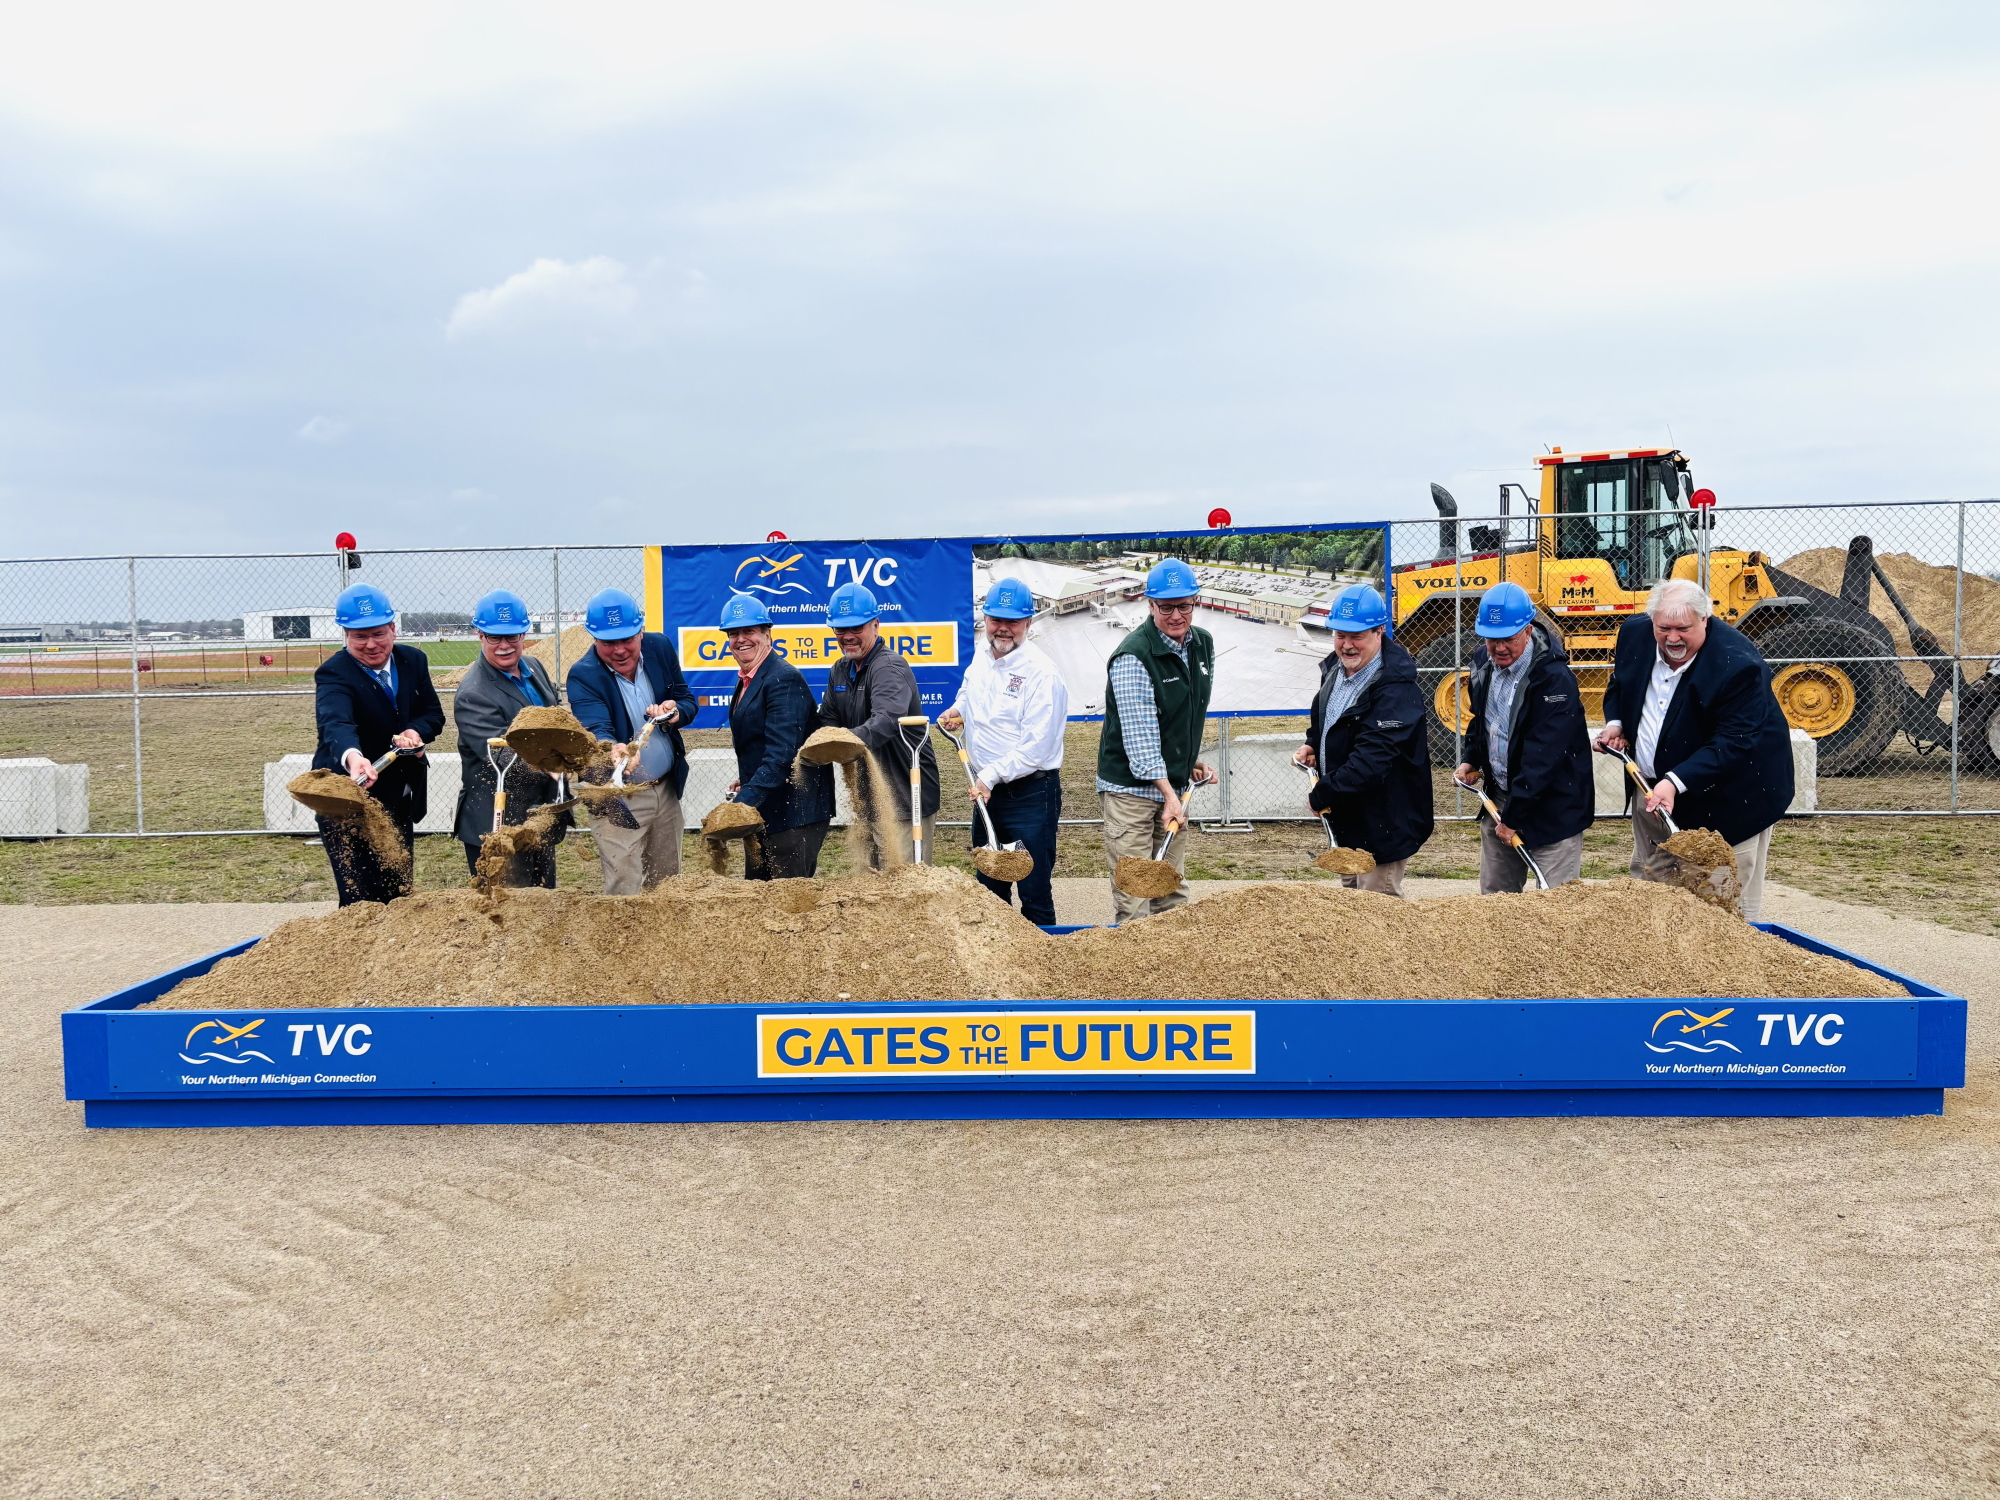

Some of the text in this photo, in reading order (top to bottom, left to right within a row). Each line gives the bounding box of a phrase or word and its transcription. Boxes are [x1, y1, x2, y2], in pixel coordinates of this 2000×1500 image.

[823, 557, 898, 587] TVC
[1413, 576, 1488, 589] VOLVO
[1562, 586, 1594, 598] M&M
[767, 604, 797, 613] rthern
[796, 637, 814, 647] TO
[792, 649, 818, 659] THE
[921, 693, 943, 701] MER
[1757, 1013, 1845, 1046] TVC
[287, 1023, 373, 1056] TVC
[776, 1023, 1232, 1066] GATES TO THE FUTURE
[1645, 1063, 1847, 1075] Your Northern Michigan Connection
[181, 1073, 377, 1086] Your Northern Michigan Connection
